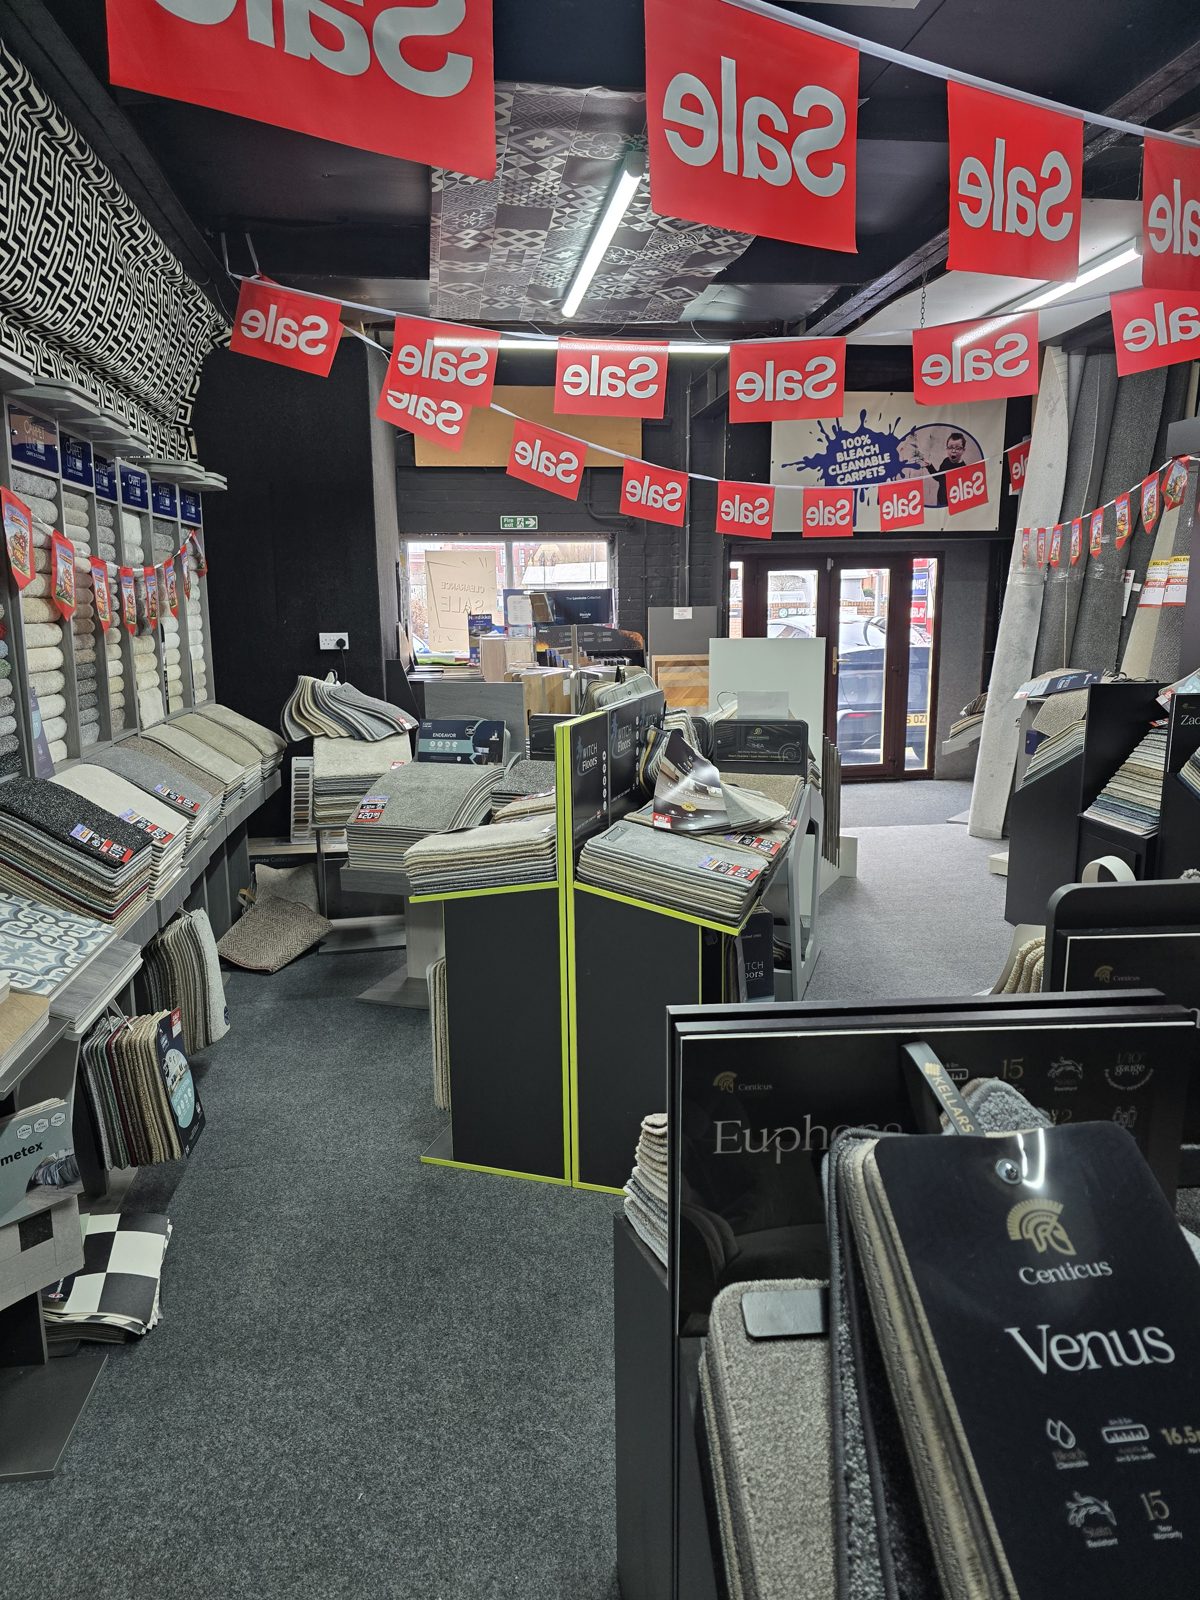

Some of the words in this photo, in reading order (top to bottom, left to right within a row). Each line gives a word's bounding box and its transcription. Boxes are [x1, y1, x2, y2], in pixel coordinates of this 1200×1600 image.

[841, 434, 872, 449] 100%
[828, 453, 891, 476] CLEANABLE
[836, 444, 880, 463] BLEACH
[836, 465, 886, 485] CARPETS
[1002, 1058, 1024, 1080] 15
[1114, 1063, 1146, 1076] gauge
[738, 1082, 773, 1092] Centicus
[932, 1074, 975, 1134] KELLARS
[713, 1113, 903, 1165] Euph
[0, 1142, 43, 1167] metex
[1018, 1258, 1113, 1286] Centicus
[1004, 1324, 1176, 1375] Venus
[1160, 1425, 1200, 1446] 16.5
[1140, 1490, 1170, 1521] 15
[1153, 1531, 1183, 1541] Warranty
